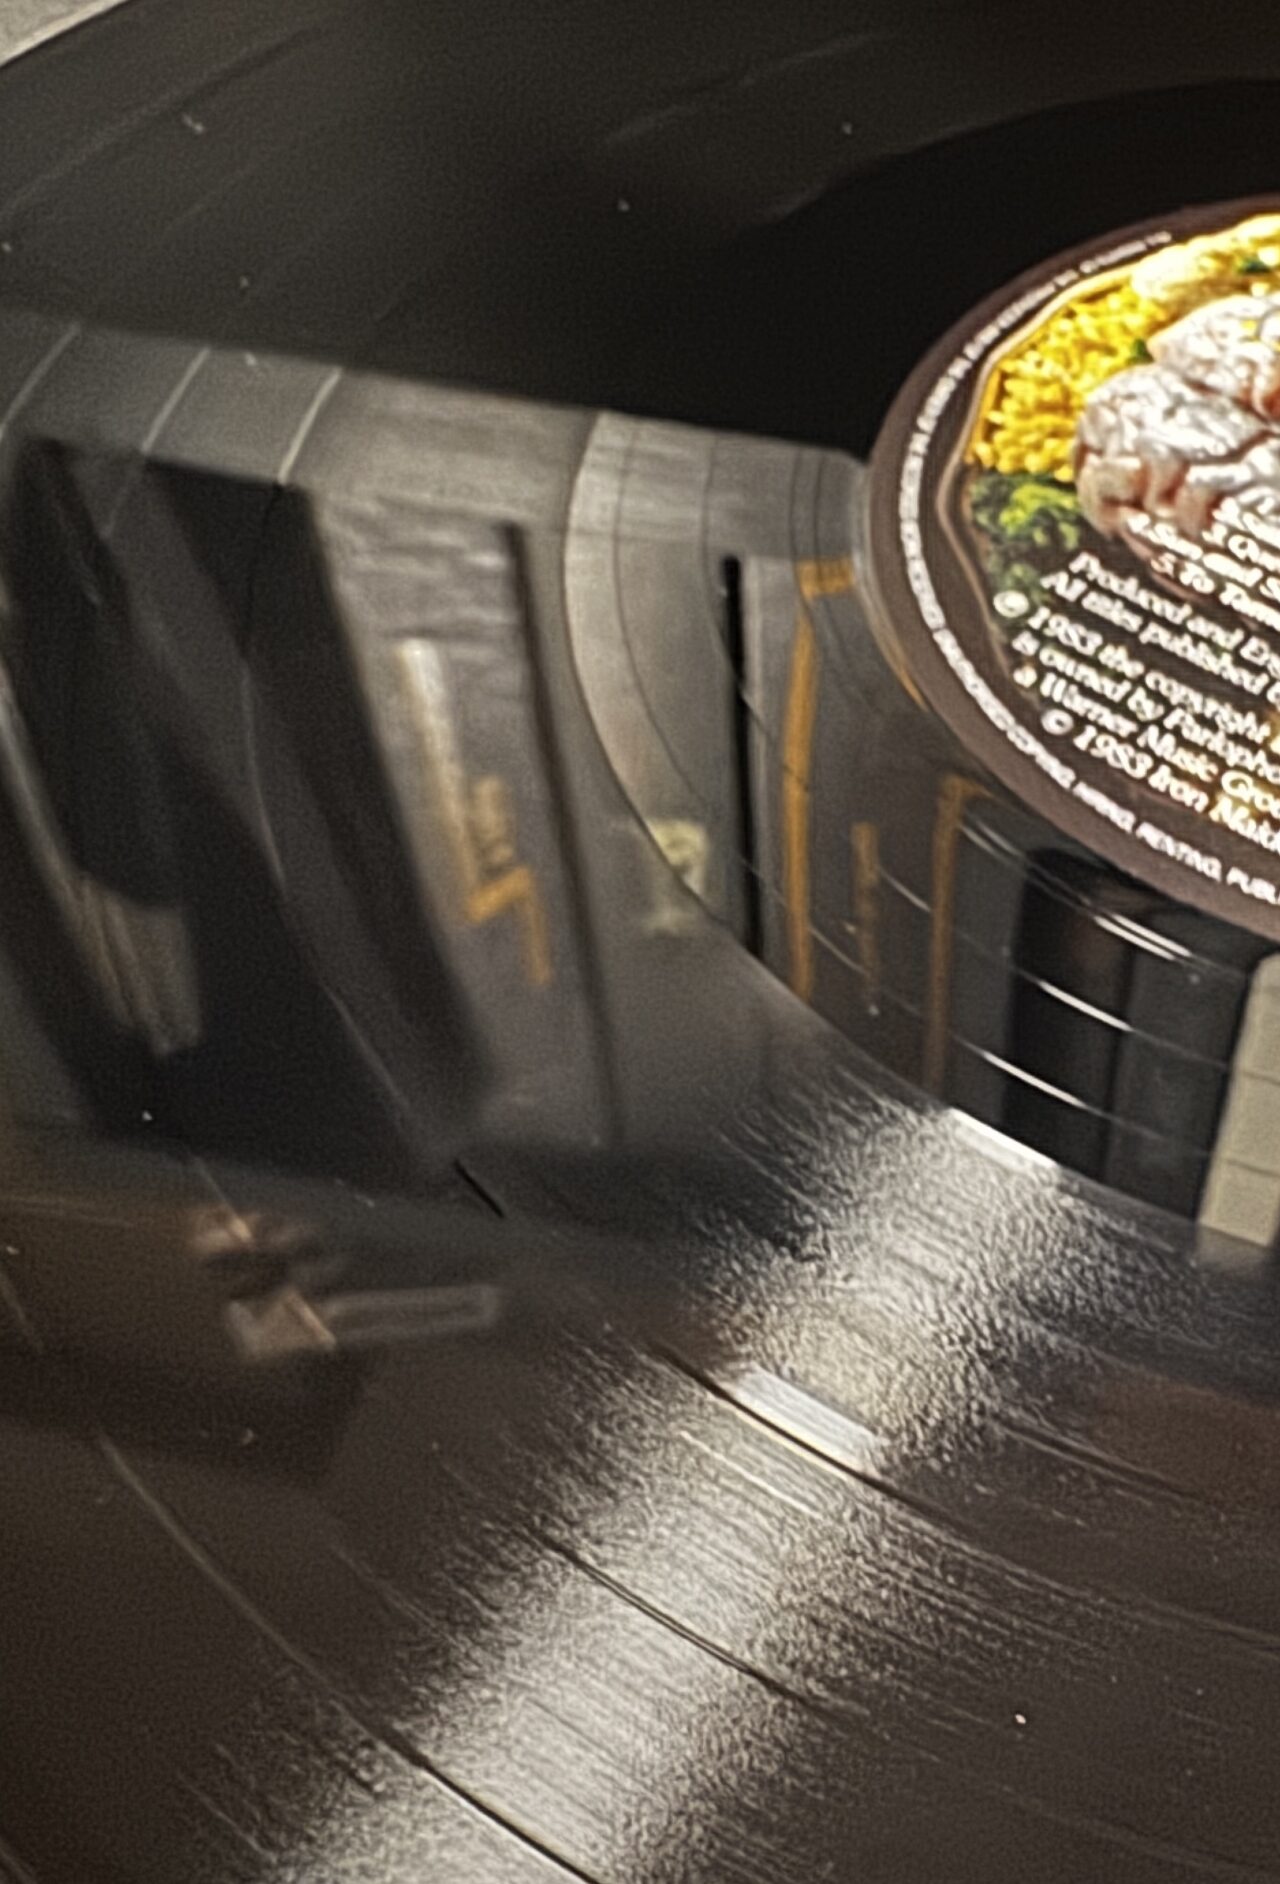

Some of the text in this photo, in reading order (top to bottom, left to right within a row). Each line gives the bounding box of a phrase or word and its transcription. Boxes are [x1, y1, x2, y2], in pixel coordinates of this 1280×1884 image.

[1039, 571, 1088, 602] All
[1138, 622, 1270, 695] published
[1068, 552, 1193, 625] Produced
[1186, 616, 1245, 651] and
[1011, 631, 1040, 657] is
[1039, 646, 1132, 703] owned
[1126, 686, 1165, 721] by
[1012, 665, 1038, 688] a
[1039, 672, 1138, 738] Warner
[1136, 724, 1219, 783] Music
[1027, 605, 1103, 656] 1983
[1097, 644, 1145, 678] the
[1136, 671, 1272, 745] copyright
[1073, 724, 1154, 779] 1983
[1147, 764, 1210, 813] Iron
